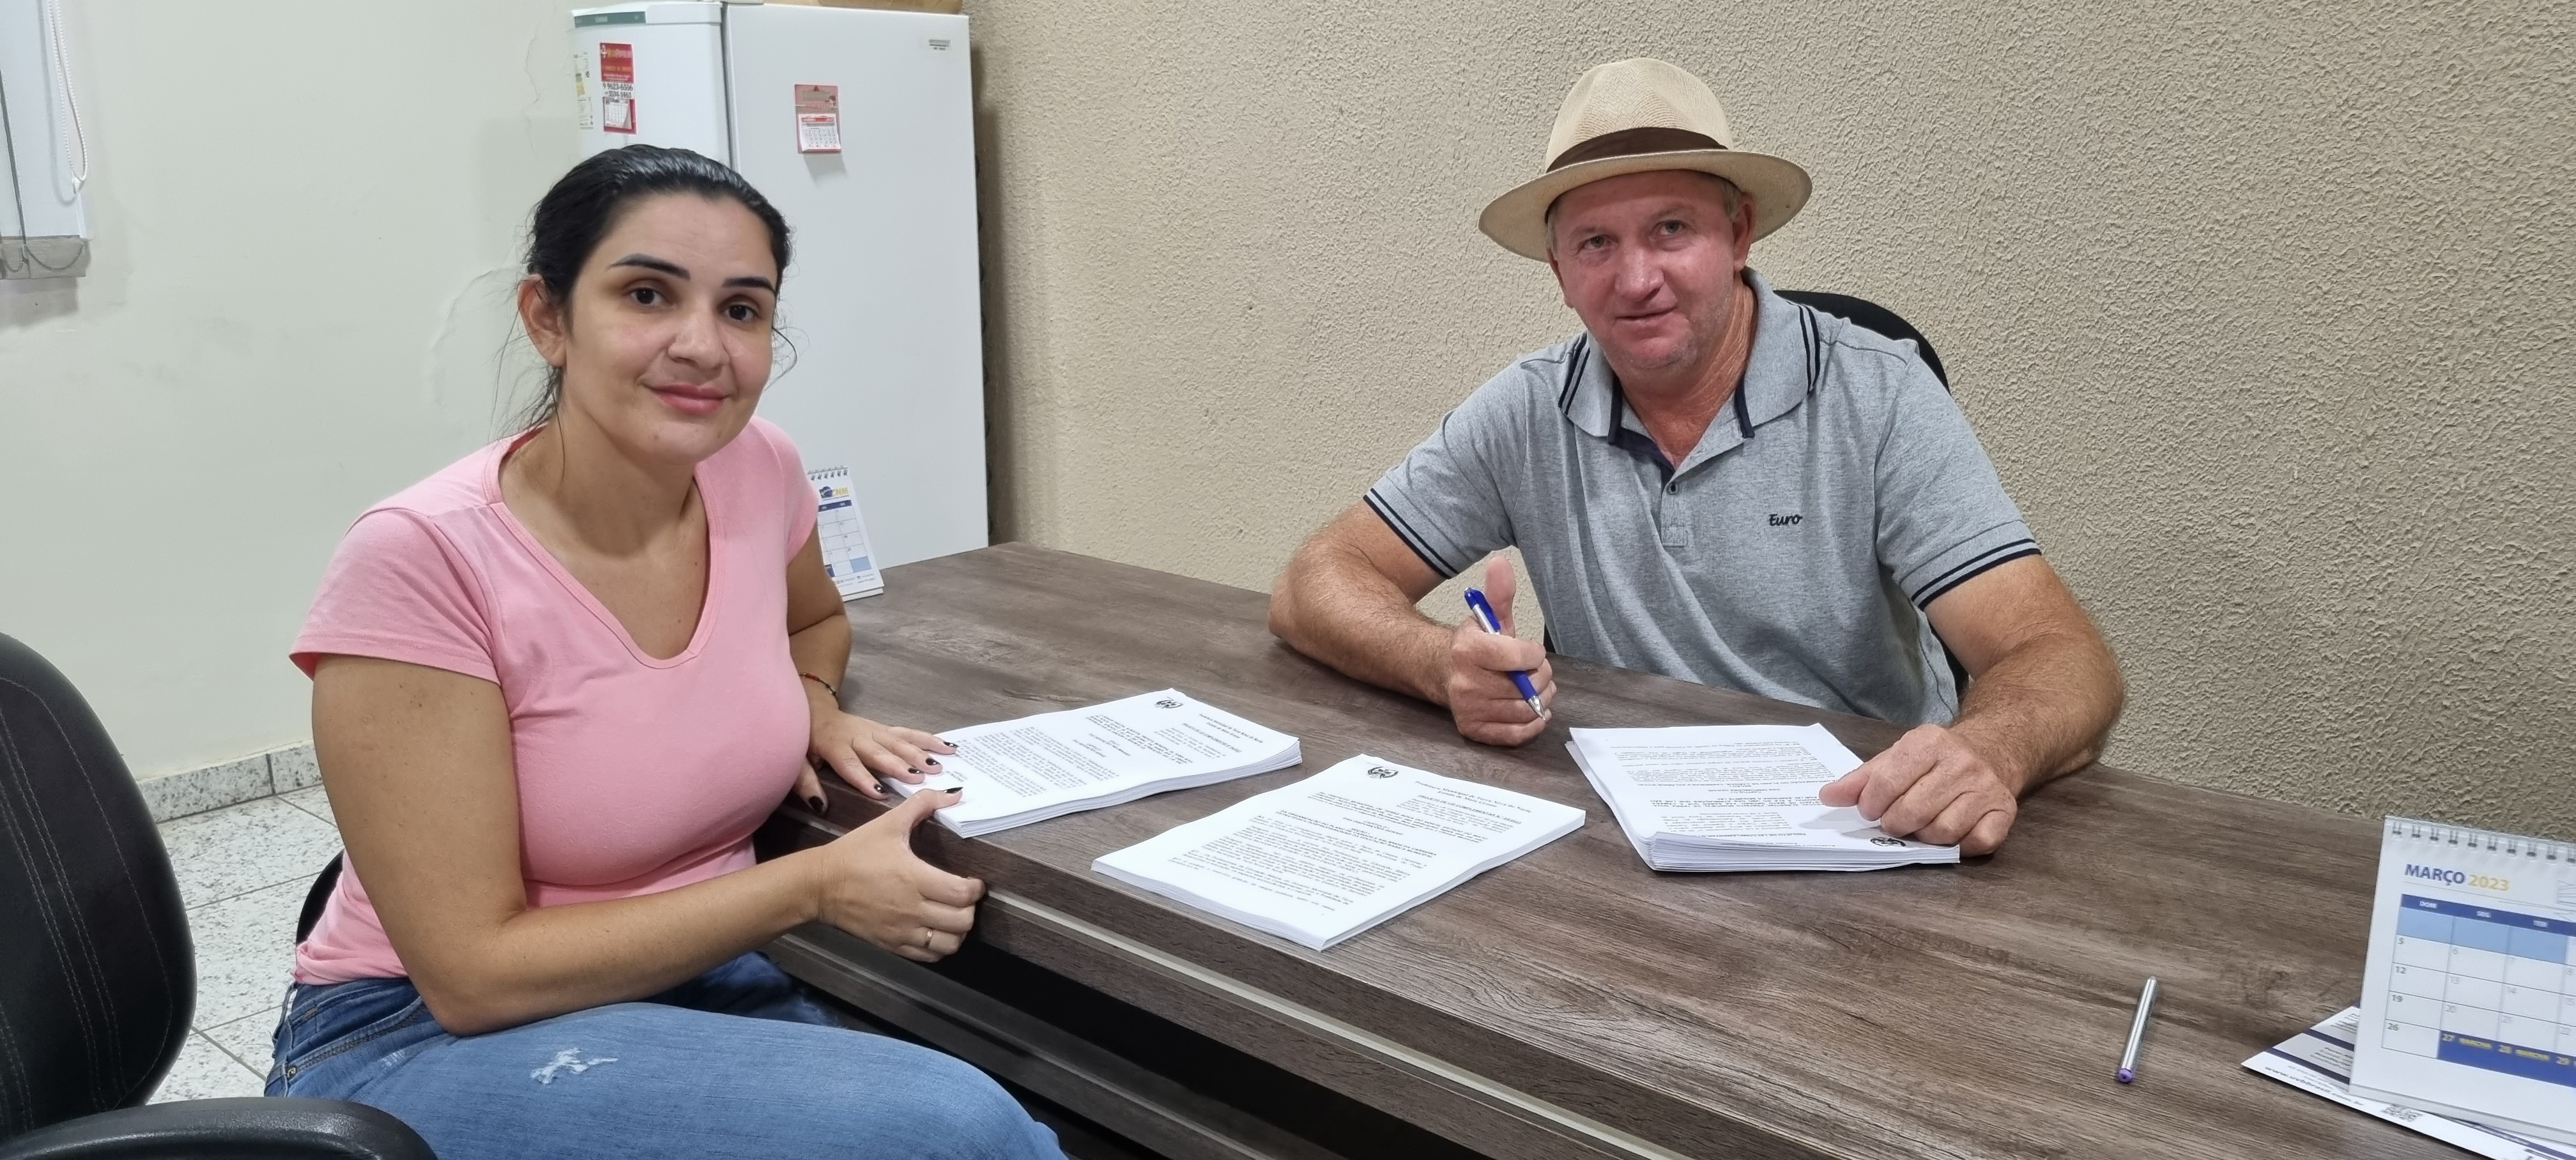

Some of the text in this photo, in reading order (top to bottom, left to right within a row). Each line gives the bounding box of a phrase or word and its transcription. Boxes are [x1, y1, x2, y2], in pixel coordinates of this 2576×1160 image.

[1768, 514, 1803, 526] Euro
[2405, 864, 2510, 891] MARÇO 2023
[2396, 966, 2406, 975] 12
[2387, 1023, 2398, 1031] 26
[2556, 1057, 2570, 1065] 29
